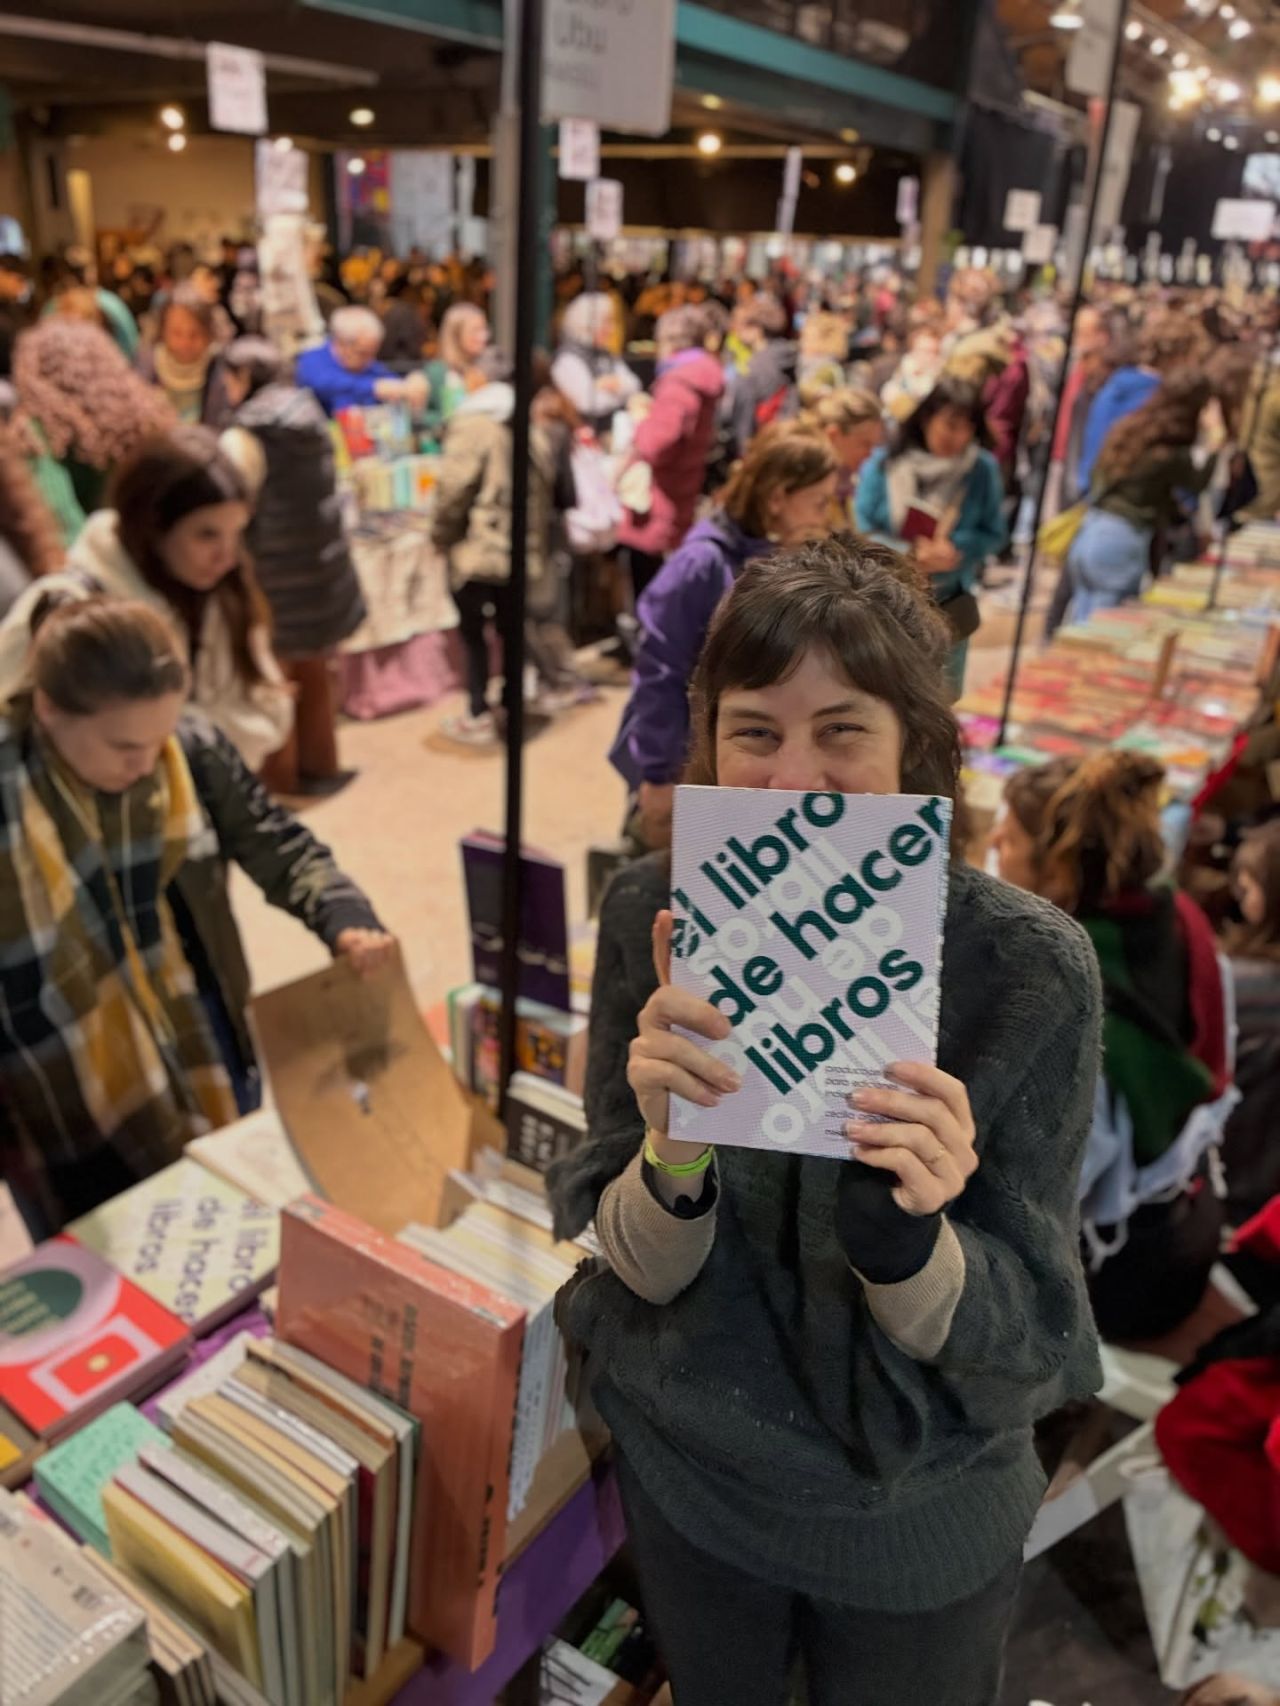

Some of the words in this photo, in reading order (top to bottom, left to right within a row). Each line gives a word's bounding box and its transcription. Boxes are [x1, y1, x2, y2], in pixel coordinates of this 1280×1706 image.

[672, 888, 717, 958] el
[699, 792, 845, 909] libro
[708, 956, 784, 1026] de
[769, 796, 947, 960] hacer
[743, 949, 923, 1096] libros
